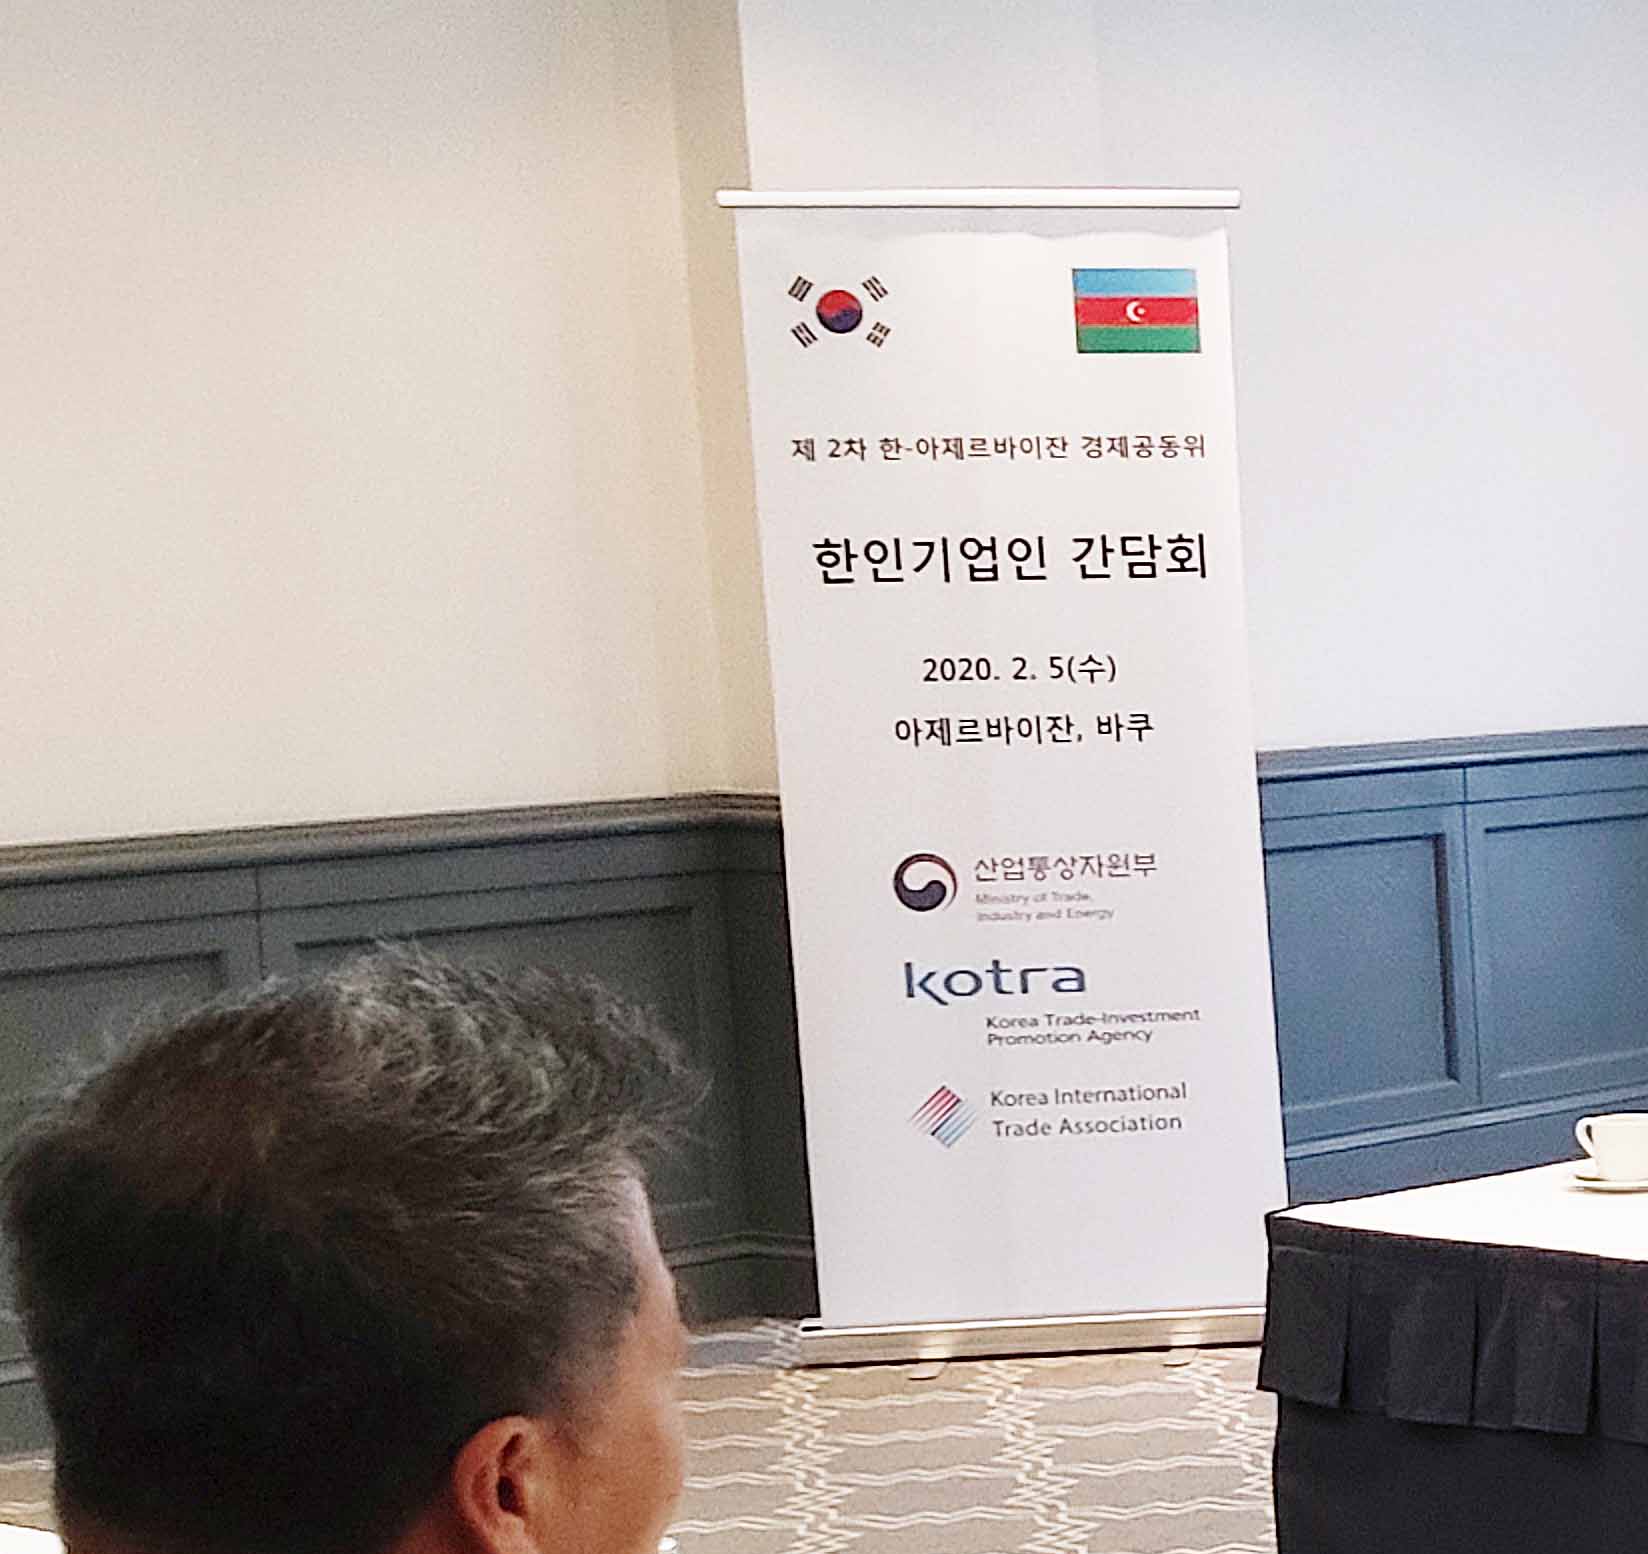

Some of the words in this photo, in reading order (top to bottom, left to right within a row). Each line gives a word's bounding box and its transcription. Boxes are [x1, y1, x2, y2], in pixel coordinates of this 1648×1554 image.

[791, 438, 816, 462] 제
[827, 438, 867, 462] 2차
[878, 436, 1068, 462] 한-아제르바이잔
[1081, 434, 1205, 460] 경제공동위
[812, 536, 1047, 585] 한인기업인
[1072, 533, 1207, 580] 간담회
[922, 658, 1000, 682] 2020.
[1012, 656, 1037, 681] 2.
[1049, 654, 1117, 685] 5(수)
[895, 713, 1083, 748] 아제르바이잔,
[1096, 713, 1155, 743] 바쿠
[974, 853, 1158, 882] 산업통상자원부
[975, 892, 1030, 907] Ministry
[1032, 890, 1048, 904] of
[977, 908, 1033, 923] Industry
[1035, 907, 1062, 921] and
[1065, 905, 1115, 922] Energy
[904, 960, 1087, 1006] kotra
[986, 1014, 1040, 1030] Korea
[1043, 1008, 1201, 1027] Trade-Investment
[986, 1030, 1083, 1047] Promotion
[1086, 1027, 1154, 1044] Agency
[990, 1089, 1049, 1108] Korea
[1054, 1081, 1188, 1105] International
[992, 1118, 1053, 1138] Trade
[1059, 1114, 1183, 1136] Association
